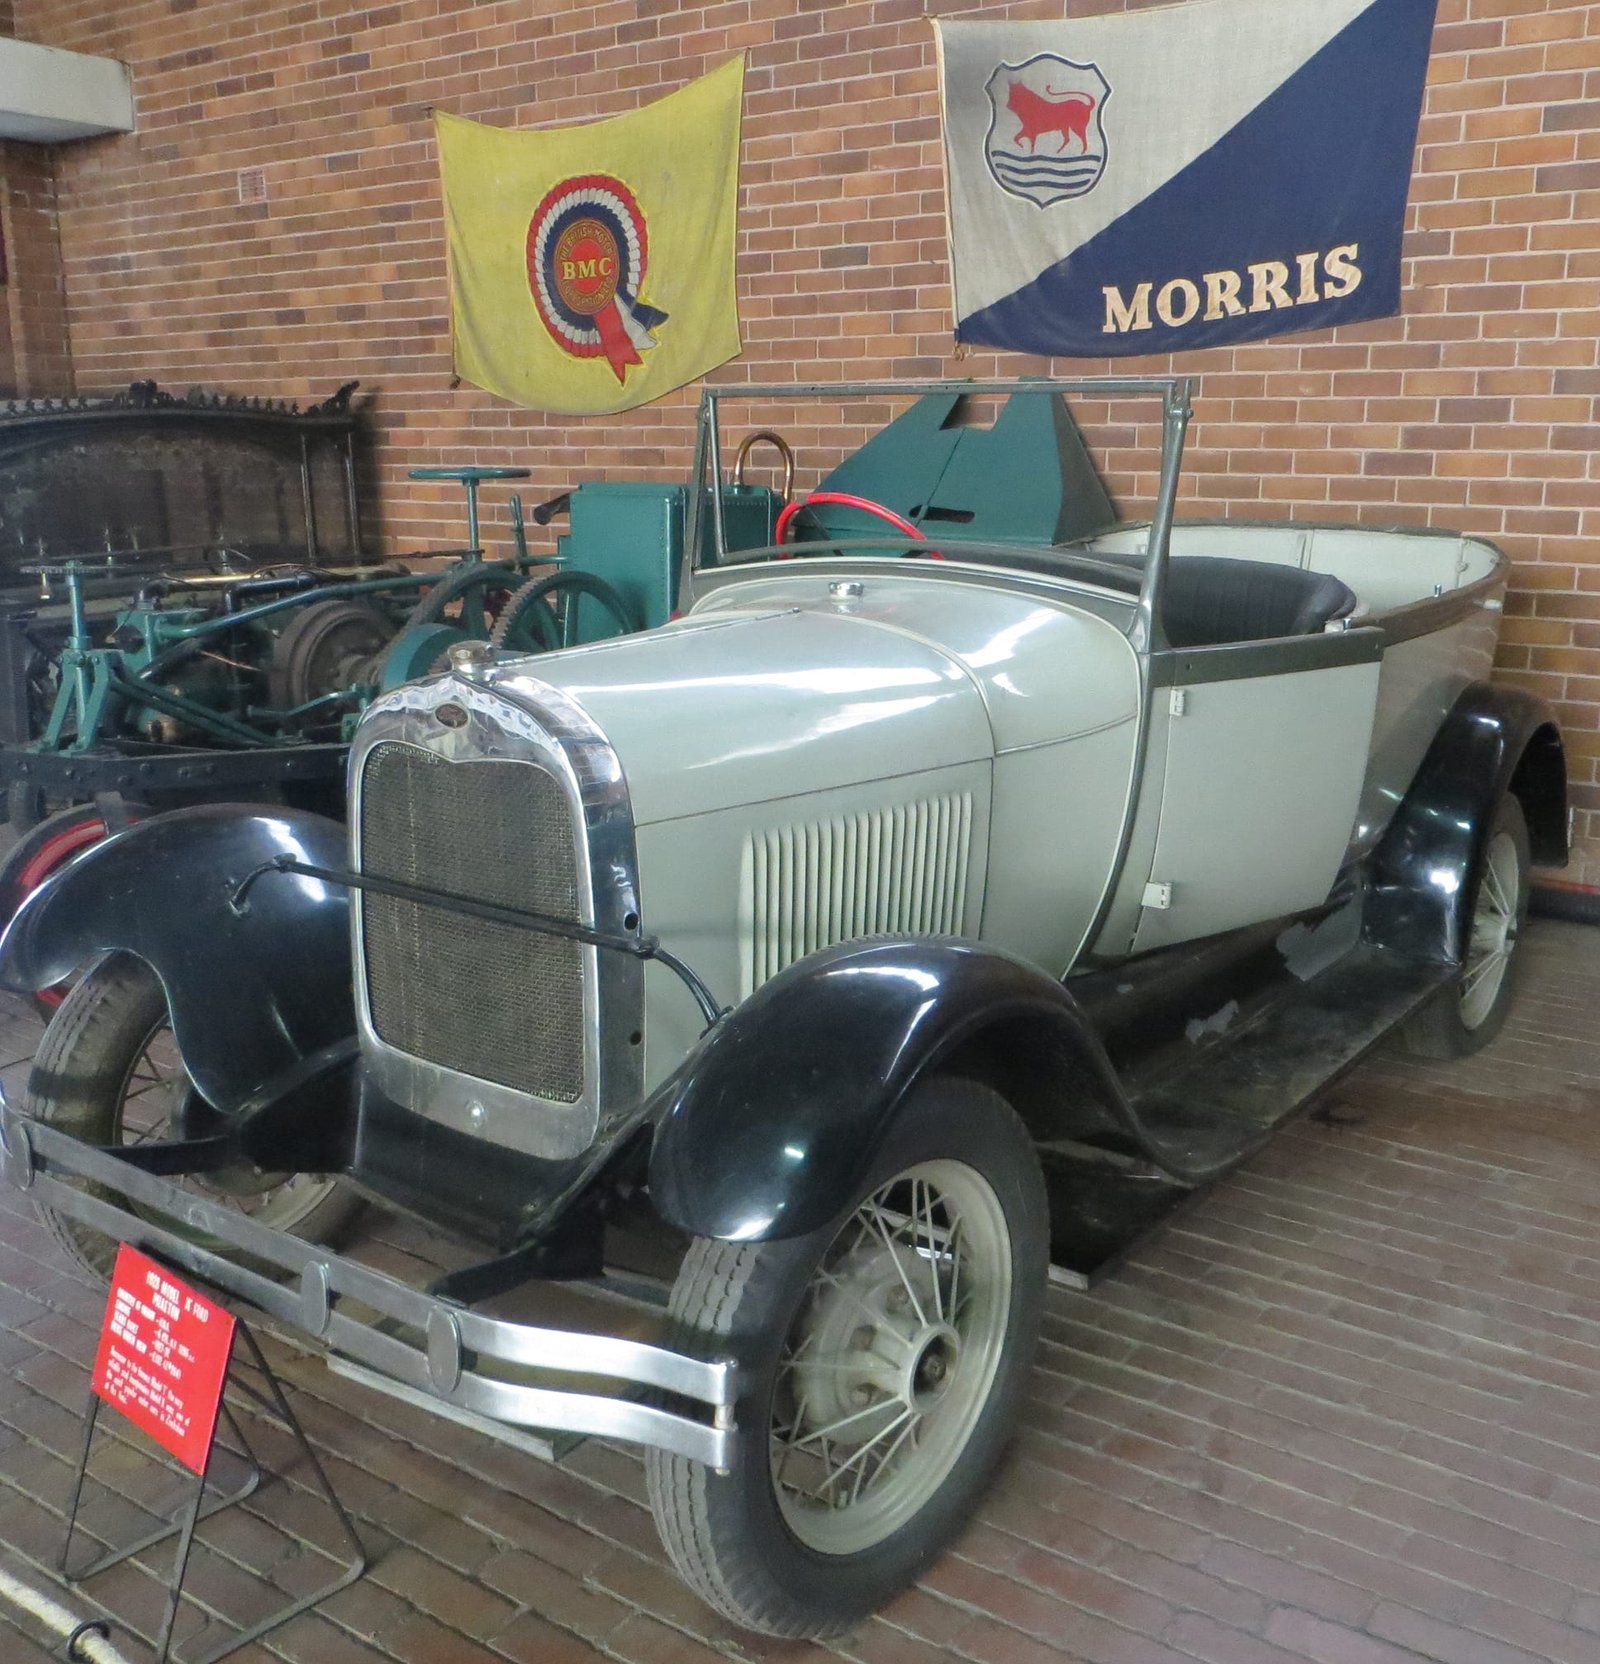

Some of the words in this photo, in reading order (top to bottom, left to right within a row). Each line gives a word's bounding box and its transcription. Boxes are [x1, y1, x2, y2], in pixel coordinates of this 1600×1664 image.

[562, 257, 612, 280] BMC
[1102, 243, 1363, 334] MORRIS
[161, 1280, 180, 1304] MODEL
[193, 1302, 209, 1324] FORD
